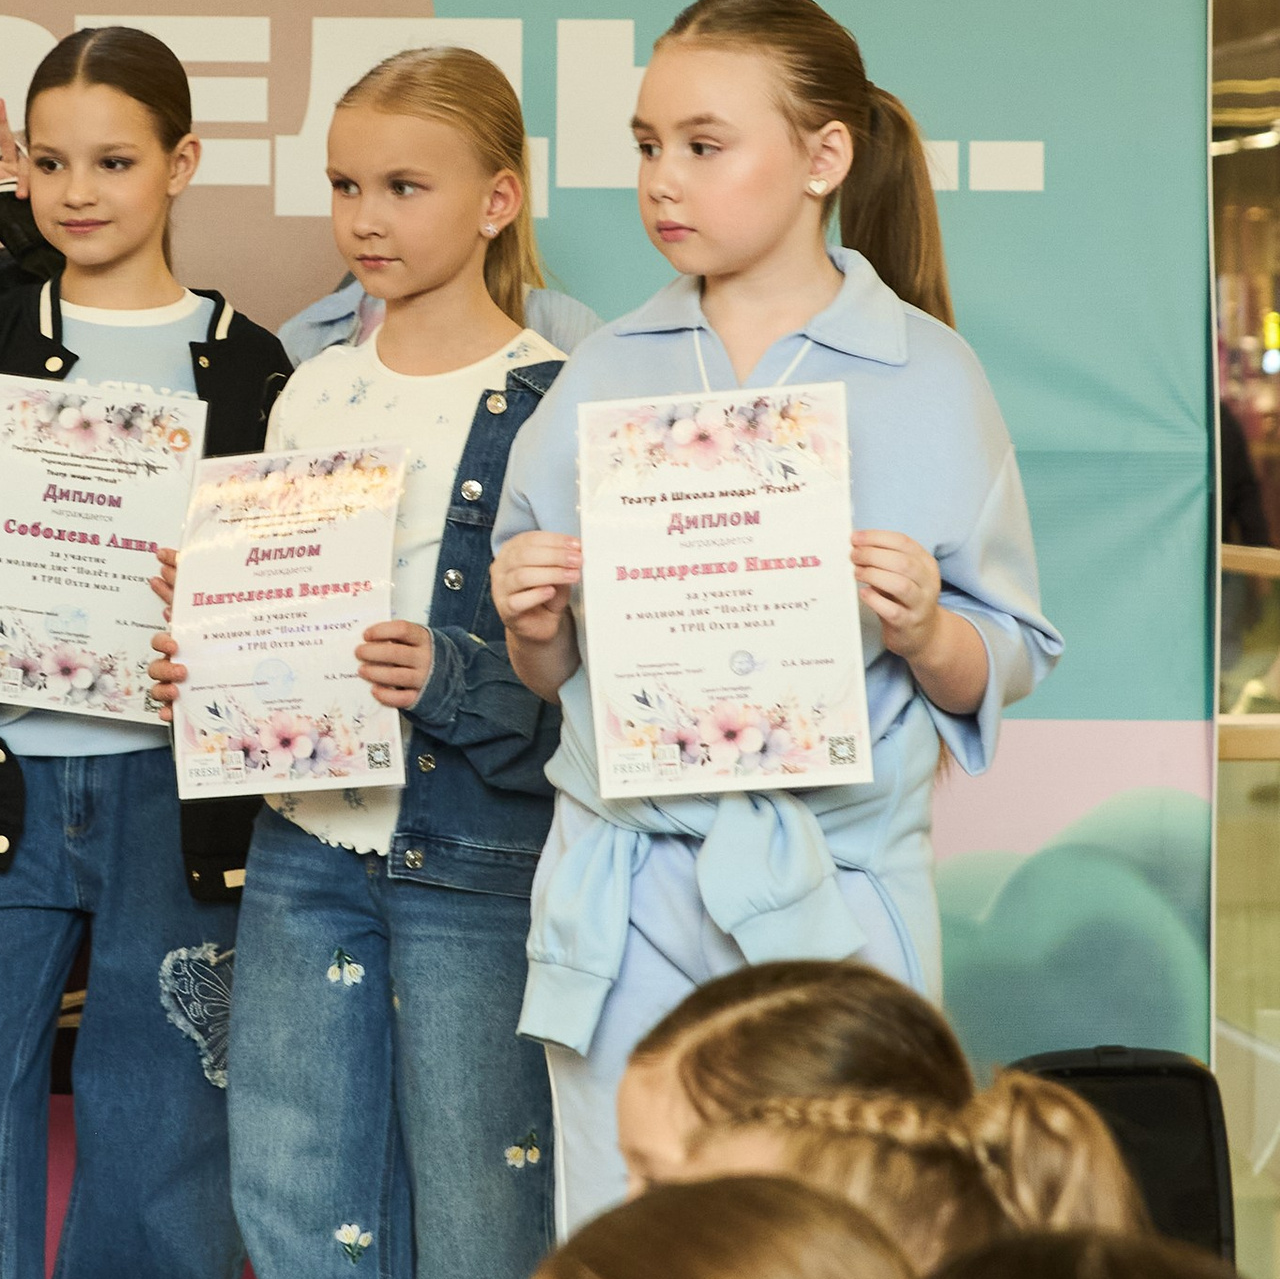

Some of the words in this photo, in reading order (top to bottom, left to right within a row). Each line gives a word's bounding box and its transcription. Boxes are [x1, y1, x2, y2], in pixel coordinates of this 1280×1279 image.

[42, 483, 123, 508] Диплом
[620, 494, 657, 507] Театр
[671, 490, 715, 502] Школа
[718, 487, 756, 498] моды
[667, 510, 761, 536] Диплом
[3, 518, 101, 546] Соболева
[105, 533, 159, 554] Анна
[245, 543, 321, 566] Диплом
[120, 574, 151, 586] весну
[615, 560, 739, 582] Бондаренко
[744, 555, 822, 573] Николь
[191, 586, 295, 607] Пантелеева
